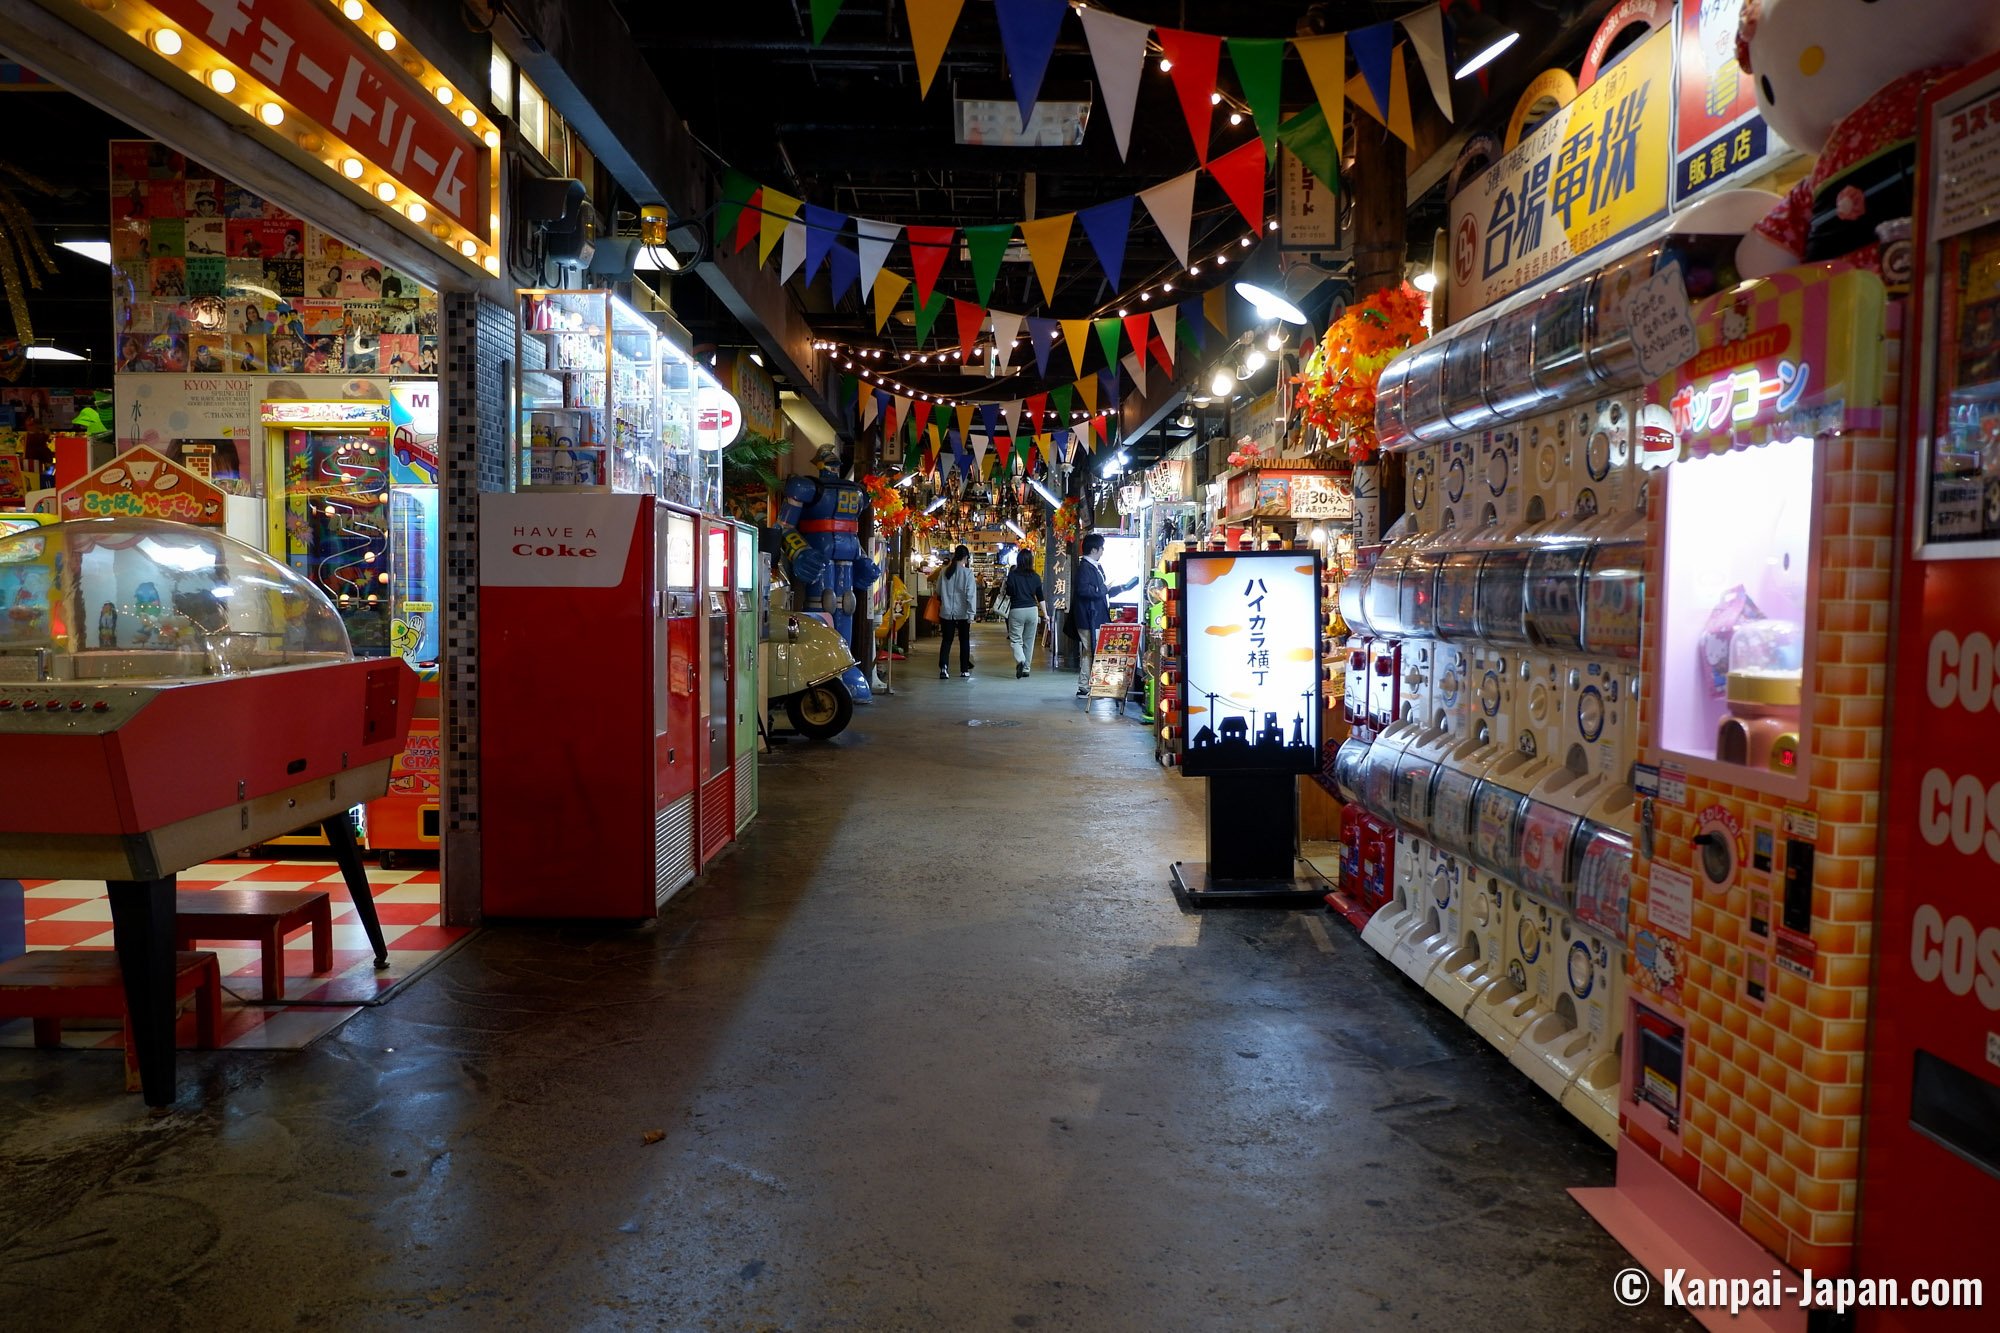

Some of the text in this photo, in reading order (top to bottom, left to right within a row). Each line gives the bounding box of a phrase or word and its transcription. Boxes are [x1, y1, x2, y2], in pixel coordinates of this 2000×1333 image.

[195, 0, 467, 218] キョードリーム
[1482, 78, 1652, 282] 台場電機
[1686, 128, 1753, 190] 販賣店
[225, 380, 249, 391] NO.1
[1694, 331, 1777, 373] HELLO KITTY
[1671, 360, 1810, 435] ポップコーン
[513, 526, 597, 538] HAVE A
[837, 491, 859, 514] 28
[512, 543, 598, 558] Coke
[1053, 530, 1066, 609] 笑似顔絵
[1243, 578, 1270, 686] ハイカラ横丁
[1926, 629, 2000, 713] CO
